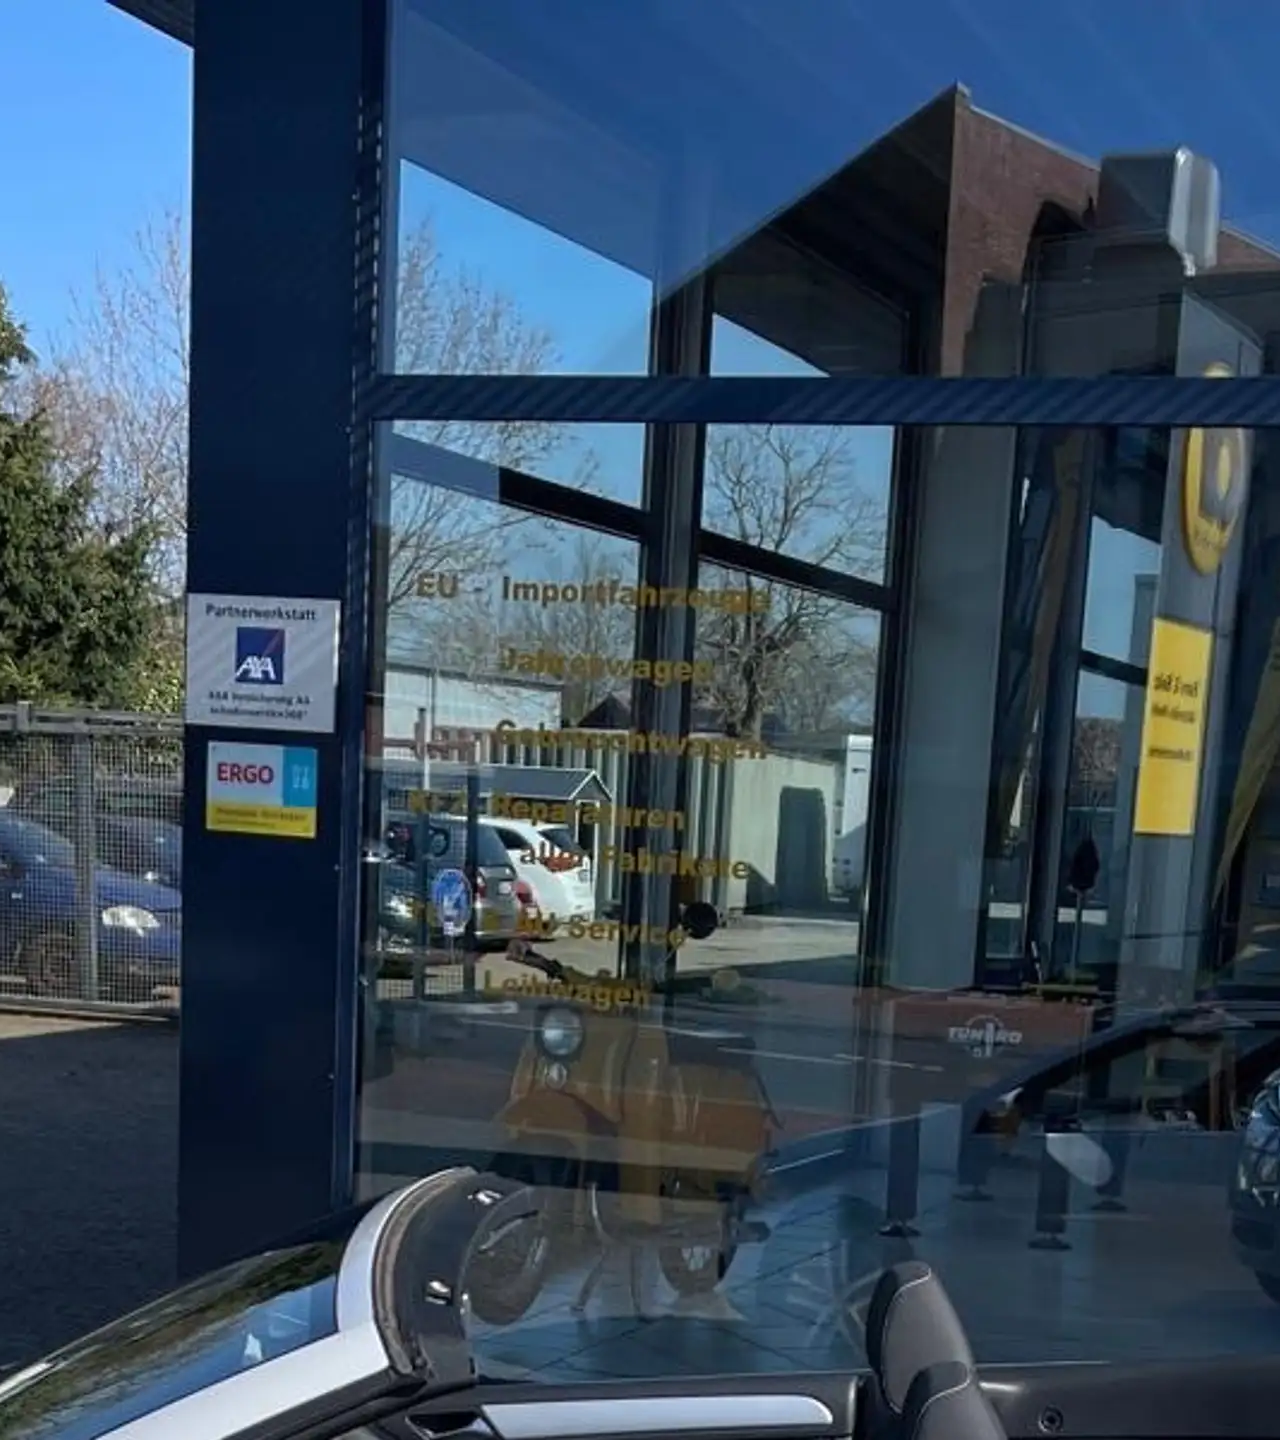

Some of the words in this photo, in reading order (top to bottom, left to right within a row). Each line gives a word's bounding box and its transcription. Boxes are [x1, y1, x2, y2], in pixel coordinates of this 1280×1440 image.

[417, 572, 458, 599] EU
[235, 656, 276, 680] AXA
[217, 761, 274, 784] ERGO
